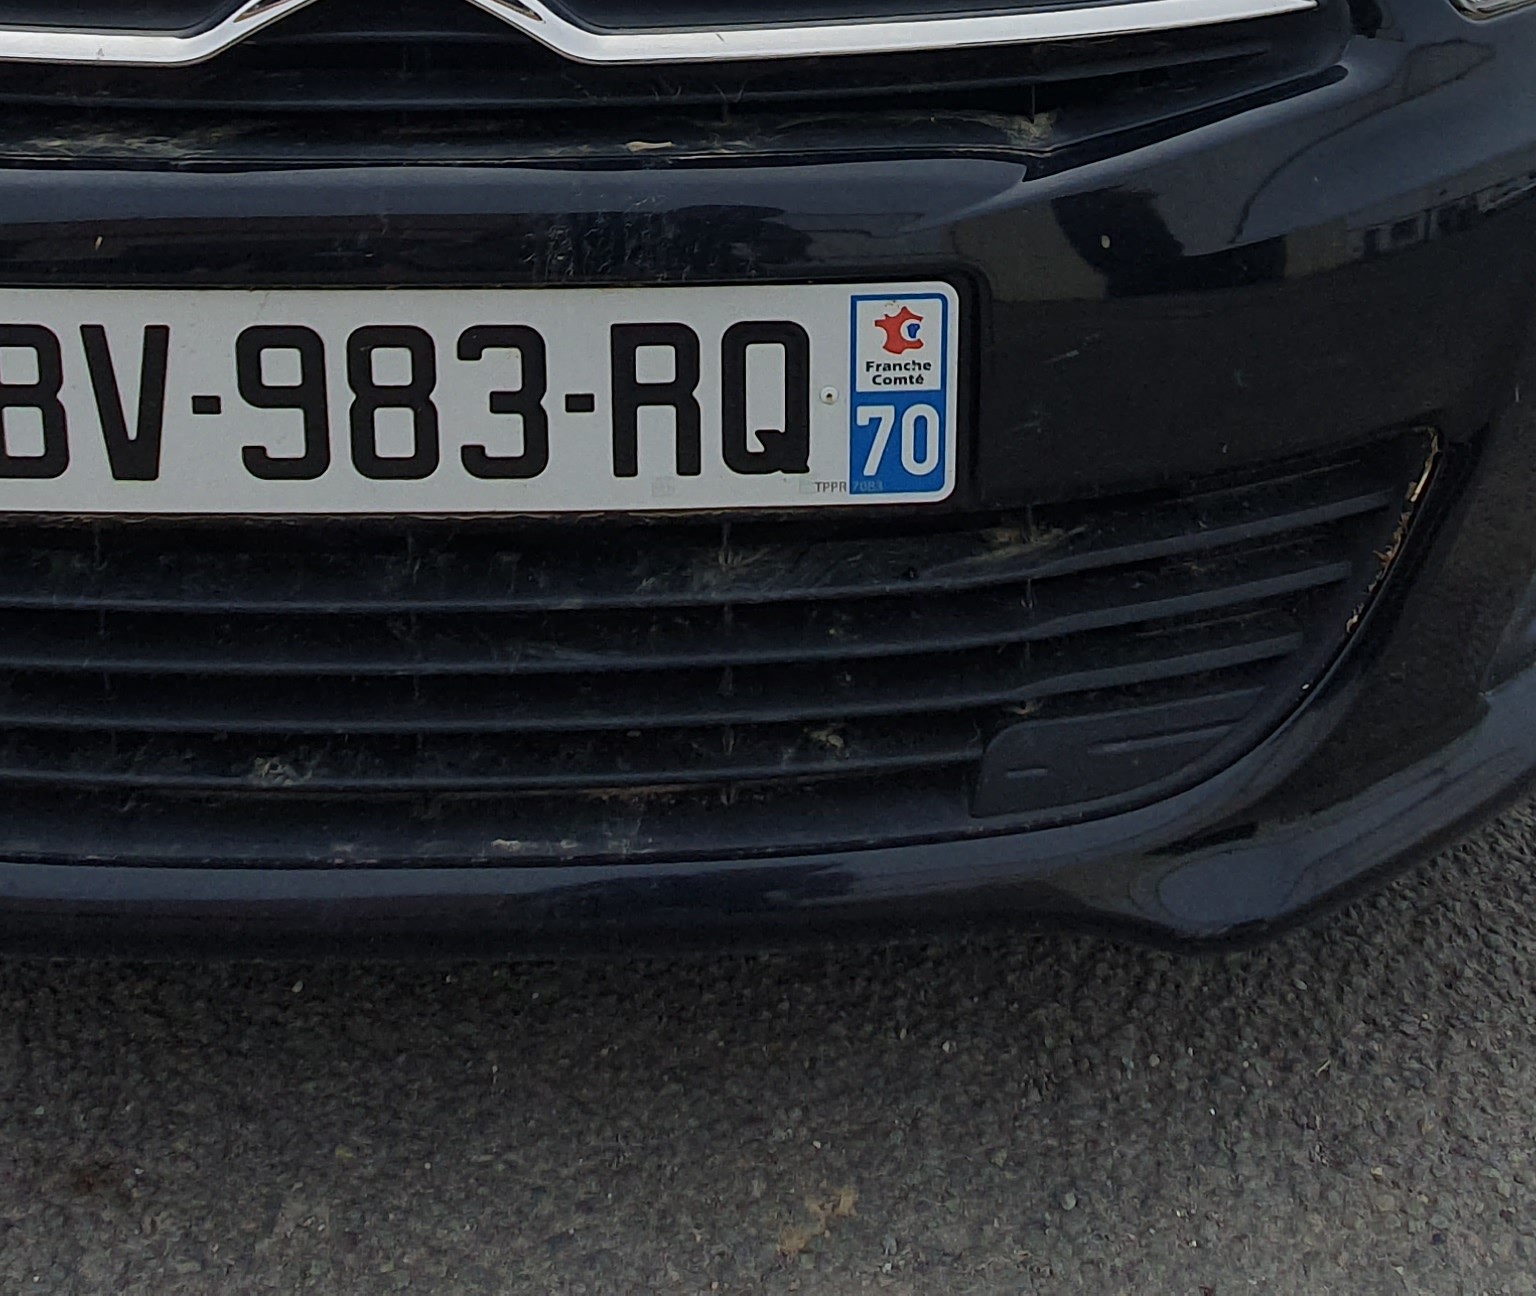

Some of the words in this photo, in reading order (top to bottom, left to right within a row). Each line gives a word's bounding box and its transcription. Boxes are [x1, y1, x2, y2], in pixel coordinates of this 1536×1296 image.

[865, 359, 932, 372] Franche
[871, 373, 925, 386] Comté
[856, 403, 940, 477] 70
[815, 481, 847, 493] TPPR
